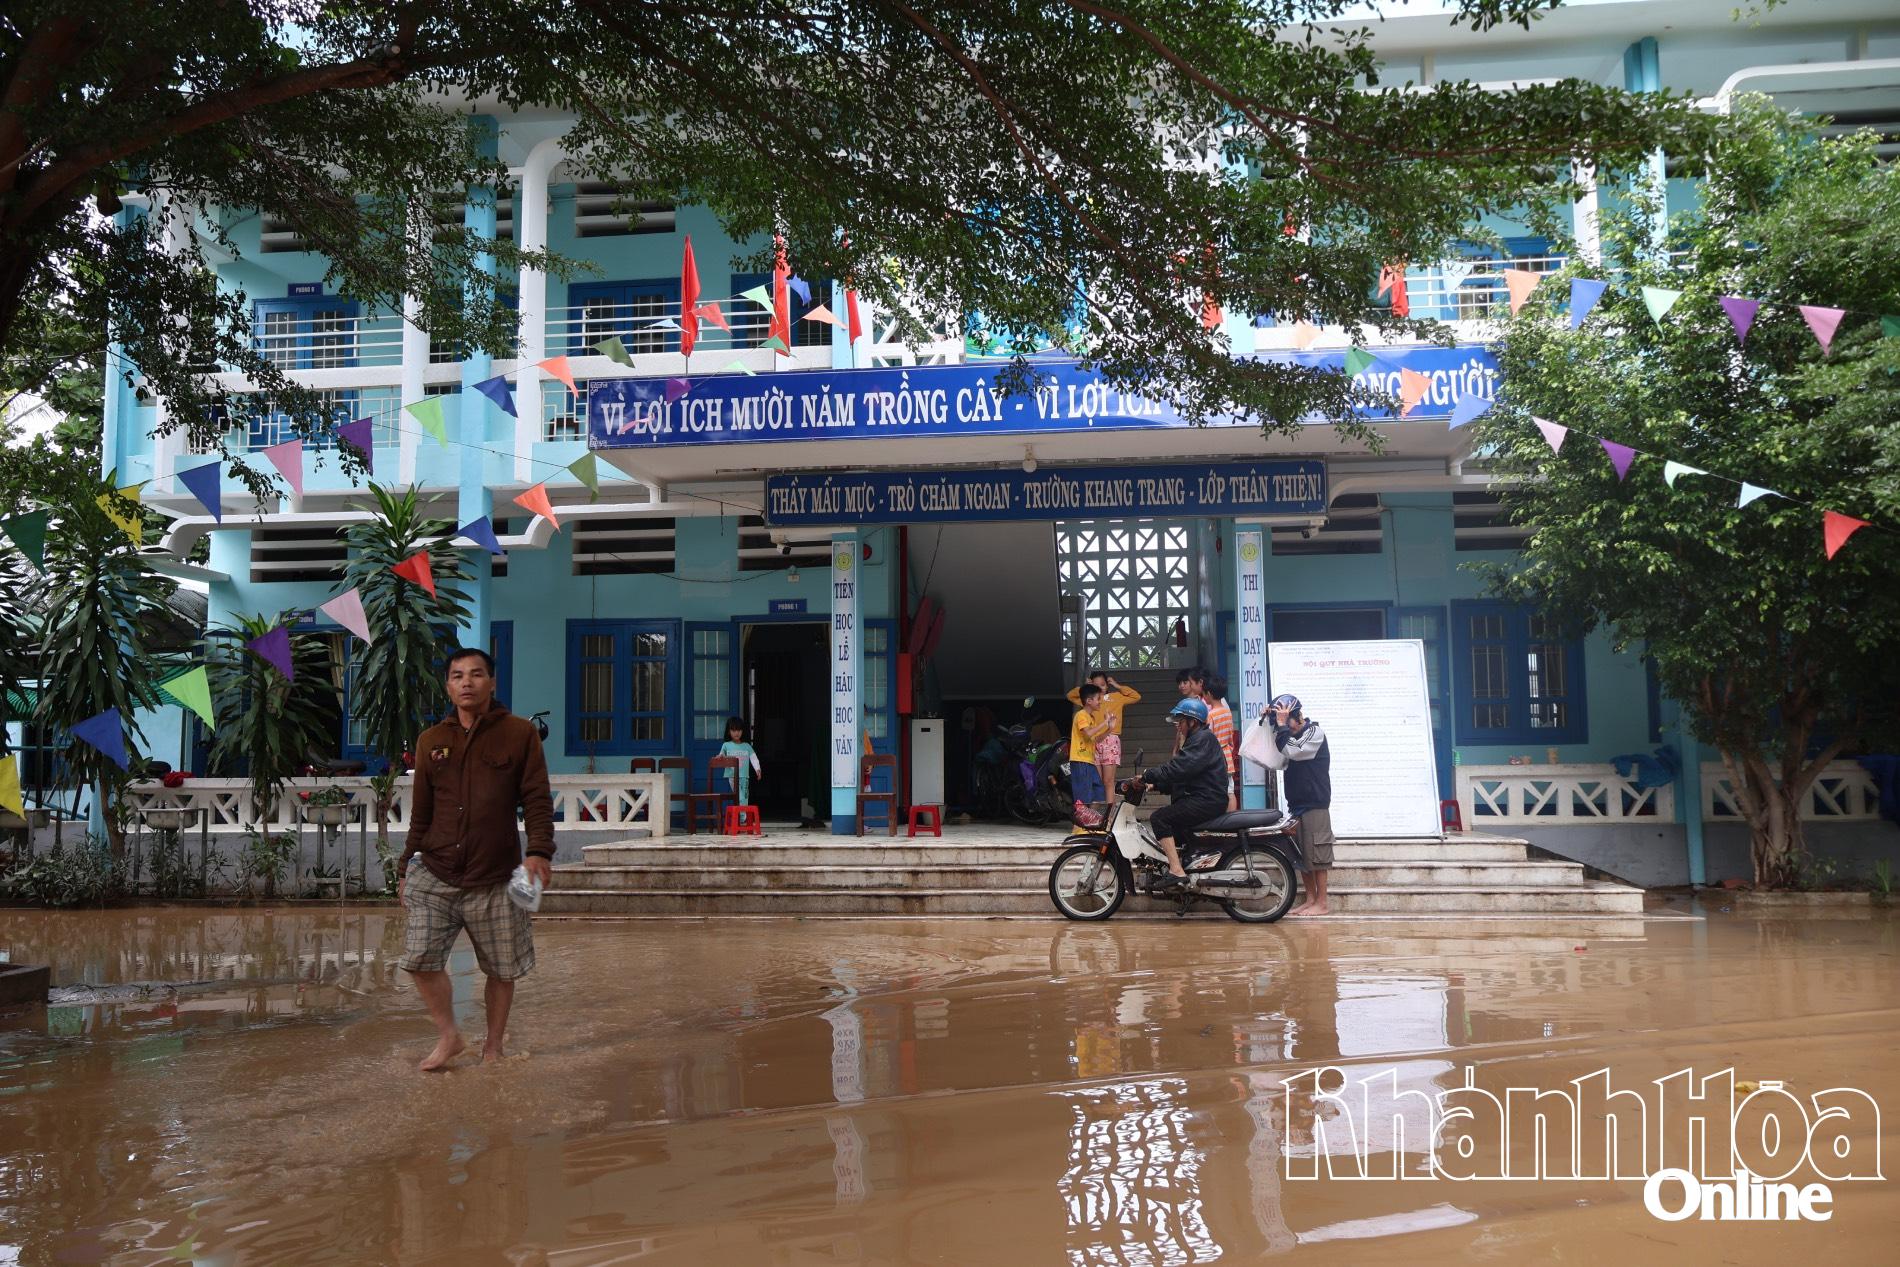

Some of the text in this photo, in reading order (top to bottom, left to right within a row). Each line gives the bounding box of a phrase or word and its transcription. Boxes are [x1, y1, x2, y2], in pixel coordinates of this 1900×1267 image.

[600, 393, 626, 436] VÌ
[633, 394, 673, 442] LỢI
[680, 392, 723, 433] ÍCH
[731, 385, 793, 431] MƯỜI
[801, 384, 855, 428] NĂM
[863, 371, 948, 426] TRỒNG
[956, 377, 1006, 423] CÂY
[1015, 403, 1024, 411] -
[1035, 376, 1060, 419] VÌ
[1067, 378, 1109, 427] LỢI
[771, 476, 808, 514] THẦY
[811, 476, 841, 514] MẪU
[844, 481, 875, 519] MỰC
[888, 477, 915, 512] TRÒ
[920, 477, 960, 511] CHĂM
[964, 482, 1010, 510] NGOAN
[1024, 473, 1080, 509] TRƯỜNG
[1084, 479, 1134, 507] KHANG
[1137, 478, 1185, 506] TRANG
[1198, 468, 1225, 505] LỚP
[1229, 468, 1269, 503] THÂN
[1273, 466, 1322, 508] THIỆN!
[834, 578, 854, 599] TIÊN
[1243, 574, 1258, 591] THI
[835, 613, 853, 633] HỌC
[1242, 606, 1261, 623] ĐUA
[838, 636, 850, 661] LỄ
[1244, 638, 1262, 658] DẠY
[835, 671, 853, 696] HẬU
[1245, 662, 1263, 687] TỐT
[835, 707, 853, 727] HỌC
